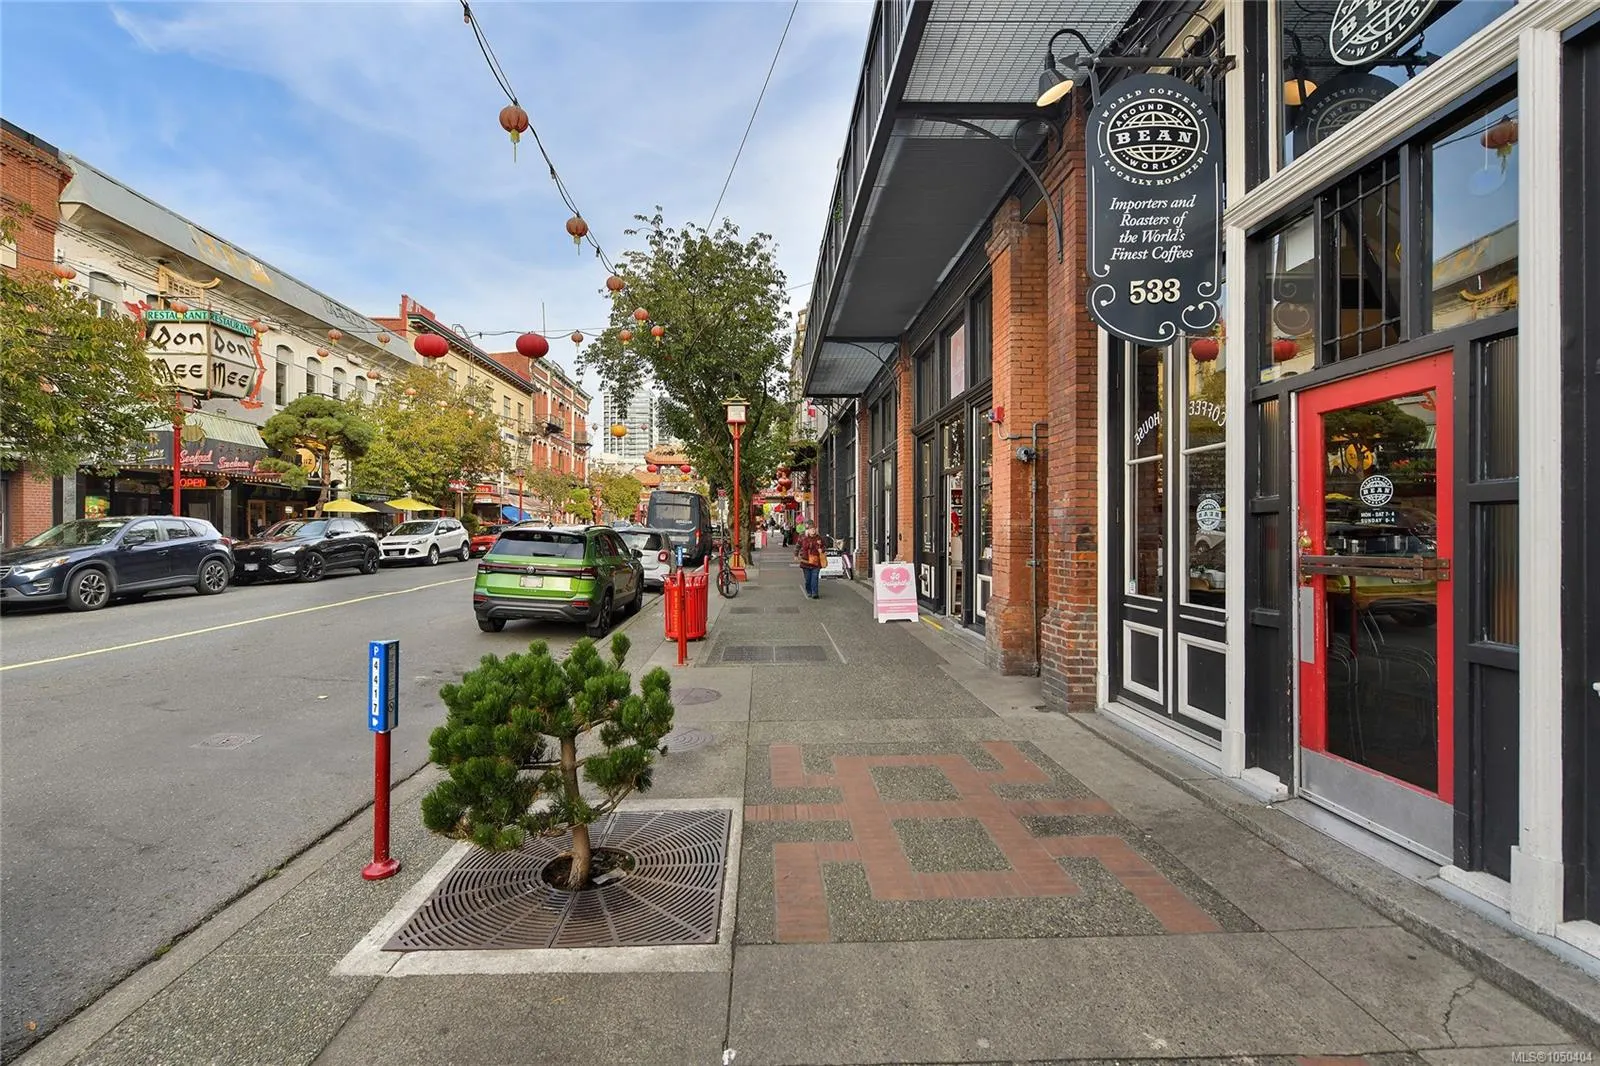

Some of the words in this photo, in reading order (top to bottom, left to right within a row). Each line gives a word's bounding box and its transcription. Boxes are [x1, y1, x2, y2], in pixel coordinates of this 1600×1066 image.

[1357, 6, 1419, 56] WORLD
[1102, 90, 1142, 118] WORLD
[1149, 88, 1203, 115] COFFEES
[1116, 104, 1163, 127] AROUND
[1171, 108, 1191, 125] THE
[1115, 130, 1192, 145] BEAN
[1104, 160, 1152, 186] LOCALLY
[1156, 157, 1203, 186] ROASTED
[1130, 159, 1178, 170] WORLD
[1109, 197, 1168, 213] Importers
[1170, 194, 1196, 208] and
[1120, 214, 1169, 226] Roasters
[1173, 211, 1188, 228] of
[1119, 230, 1138, 243] the
[1141, 229, 1186, 243] World's
[1110, 247, 1148, 260] Finest
[1151, 245, 1194, 263] Coffees
[1129, 278, 1181, 304] 533
[152, 326, 204, 349] Don
[213, 329, 250, 358] Don
[213, 362, 250, 388] Mee
[180, 478, 207, 488] OPEN
[1363, 487, 1390, 495] BEAN
[374, 646, 379, 656] P
